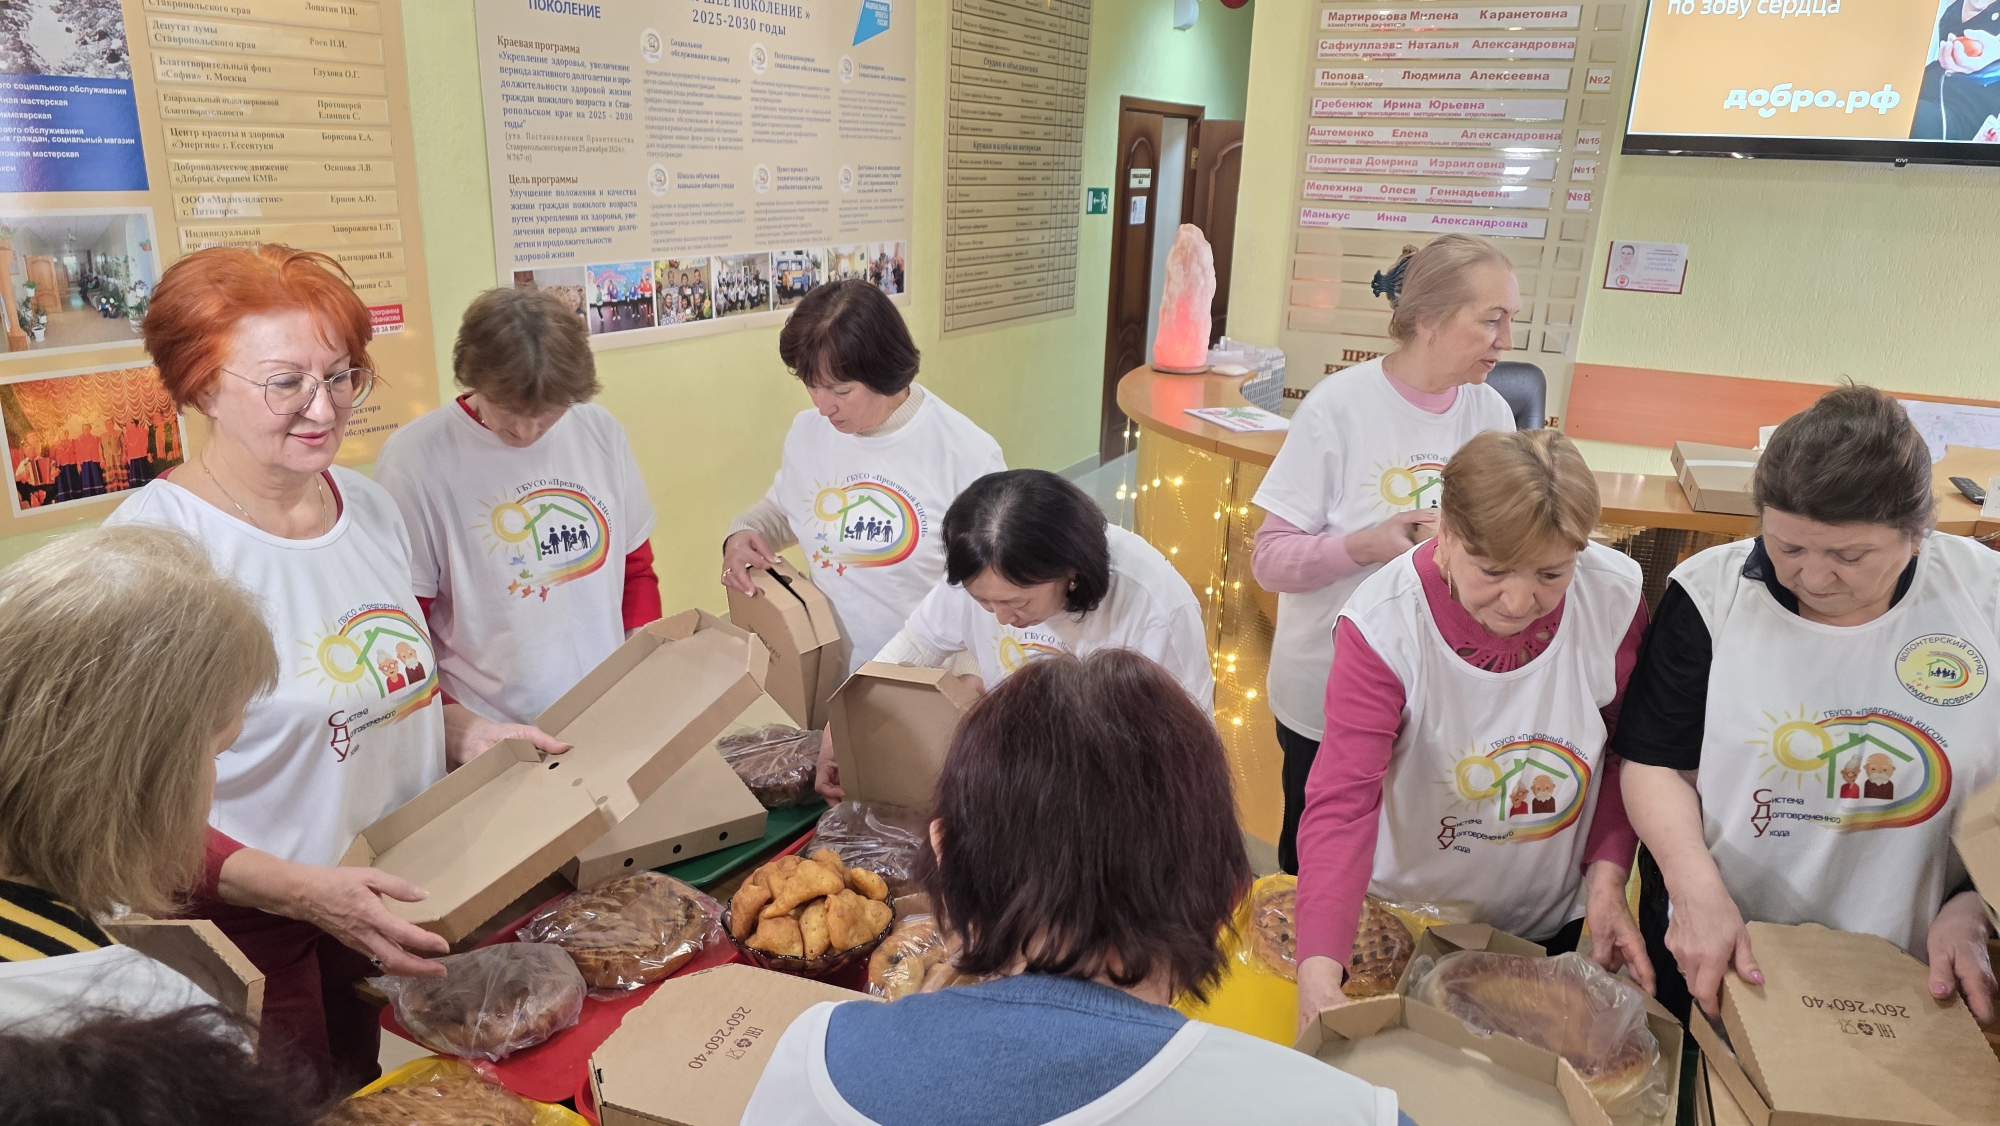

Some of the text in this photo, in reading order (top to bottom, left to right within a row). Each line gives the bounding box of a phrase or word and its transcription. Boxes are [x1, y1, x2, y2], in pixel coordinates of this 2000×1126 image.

[231, 6, 251, 15] края
[1668, 0, 1841, 19] по зову сердца
[693, 9, 786, 36] 2025-2030 годы
[1328, 12, 1407, 23] Мартиросова
[1480, 10, 1568, 21] Каранетовна
[153, 20, 217, 35] Депутат думы
[155, 33, 256, 50] Ставропольского края
[497, 35, 580, 55] Краевая программа
[1408, 40, 1575, 51] Наталья Александровна
[159, 57, 271, 73] Благотворительный фонд
[499, 51, 630, 72] «Укрепление здоровья, увеличение
[161, 69, 247, 82] «София» Москва
[313, 68, 343, 78] Глухова
[500, 65, 611, 83] периода активного долголетия
[1322, 71, 1550, 81] Попова Людмила Алексеевна
[1589, 76, 1610, 85] №2
[13, 82, 127, 95] социального обслуживания
[501, 79, 631, 97] должительности здоровой жизни
[20, 98, 68, 107] мастерская
[502, 93, 606, 108] граждан пожилого возраста
[1315, 100, 1485, 111] Гребенюк Ирина Юрьевна
[1723, 83, 1900, 116] добро.рф
[503, 106, 633, 121] ропольском крае 2025 2030
[24, 126, 84, 135] обслуживания
[170, 127, 285, 140] Центр красоты здоровья
[1309, 128, 1374, 138] Аштеменко
[1392, 128, 1428, 138] Елена
[13, 135, 50, 144] граждан,
[52, 136, 102, 144] социальный
[322, 133, 357, 142] Борисова
[1578, 137, 1600, 145] №15
[172, 140, 274, 151] «Энергия» Ессентуки
[174, 162, 248, 172] Добровольческое
[1309, 155, 1362, 165] Политова
[1366, 157, 1418, 167] Домрина
[324, 164, 356, 172] Осипова
[1574, 166, 1596, 174] №11
[509, 174, 578, 186] Цель программы
[509, 189, 552, 199] Улучшение
[1306, 182, 1510, 198] Мелехина Олеся Геннадьевна
[1568, 192, 1591, 201] №8
[181, 196, 205, 204] ООО
[330, 195, 355, 204] Ершов
[511, 200, 637, 211] жизни граждан пожилого возраста
[511, 215, 534, 225] путем
[536, 214, 578, 224] укрепления
[1302, 209, 1528, 229] Манькус Инна Александровна
[185, 228, 261, 238] Индивидуальный
[513, 227, 545, 236] личения
[548, 226, 577, 236] периода
[580, 225, 614, 233] активного
[514, 237, 613, 249] летия продолжительности
[514, 251, 550, 262] здоровой
[345, 423, 398, 437] обслуживания
[1410, 453, 1439, 462] ГБУСО
[516, 479, 546, 494] ГБУСО
[846, 473, 929, 537] ГБУСО «Предгорный КЦСОН»
[338, 608, 357, 626] ГБУСО
[1024, 631, 1055, 644] ГБУСО
[1899, 636, 1984, 675] ВОЛОНТЕРСКИЙ ОТРЯД
[1905, 683, 1974, 706] «РАДУГА ДОБРА»
[1823, 708, 1948, 748] ГБУСО КЦСОН»
[1490, 735, 1515, 749] ГБУСО
[1753, 788, 1804, 805] Система
[1753, 821, 1790, 838] Ухода
[1438, 838, 1471, 854] Ухода
